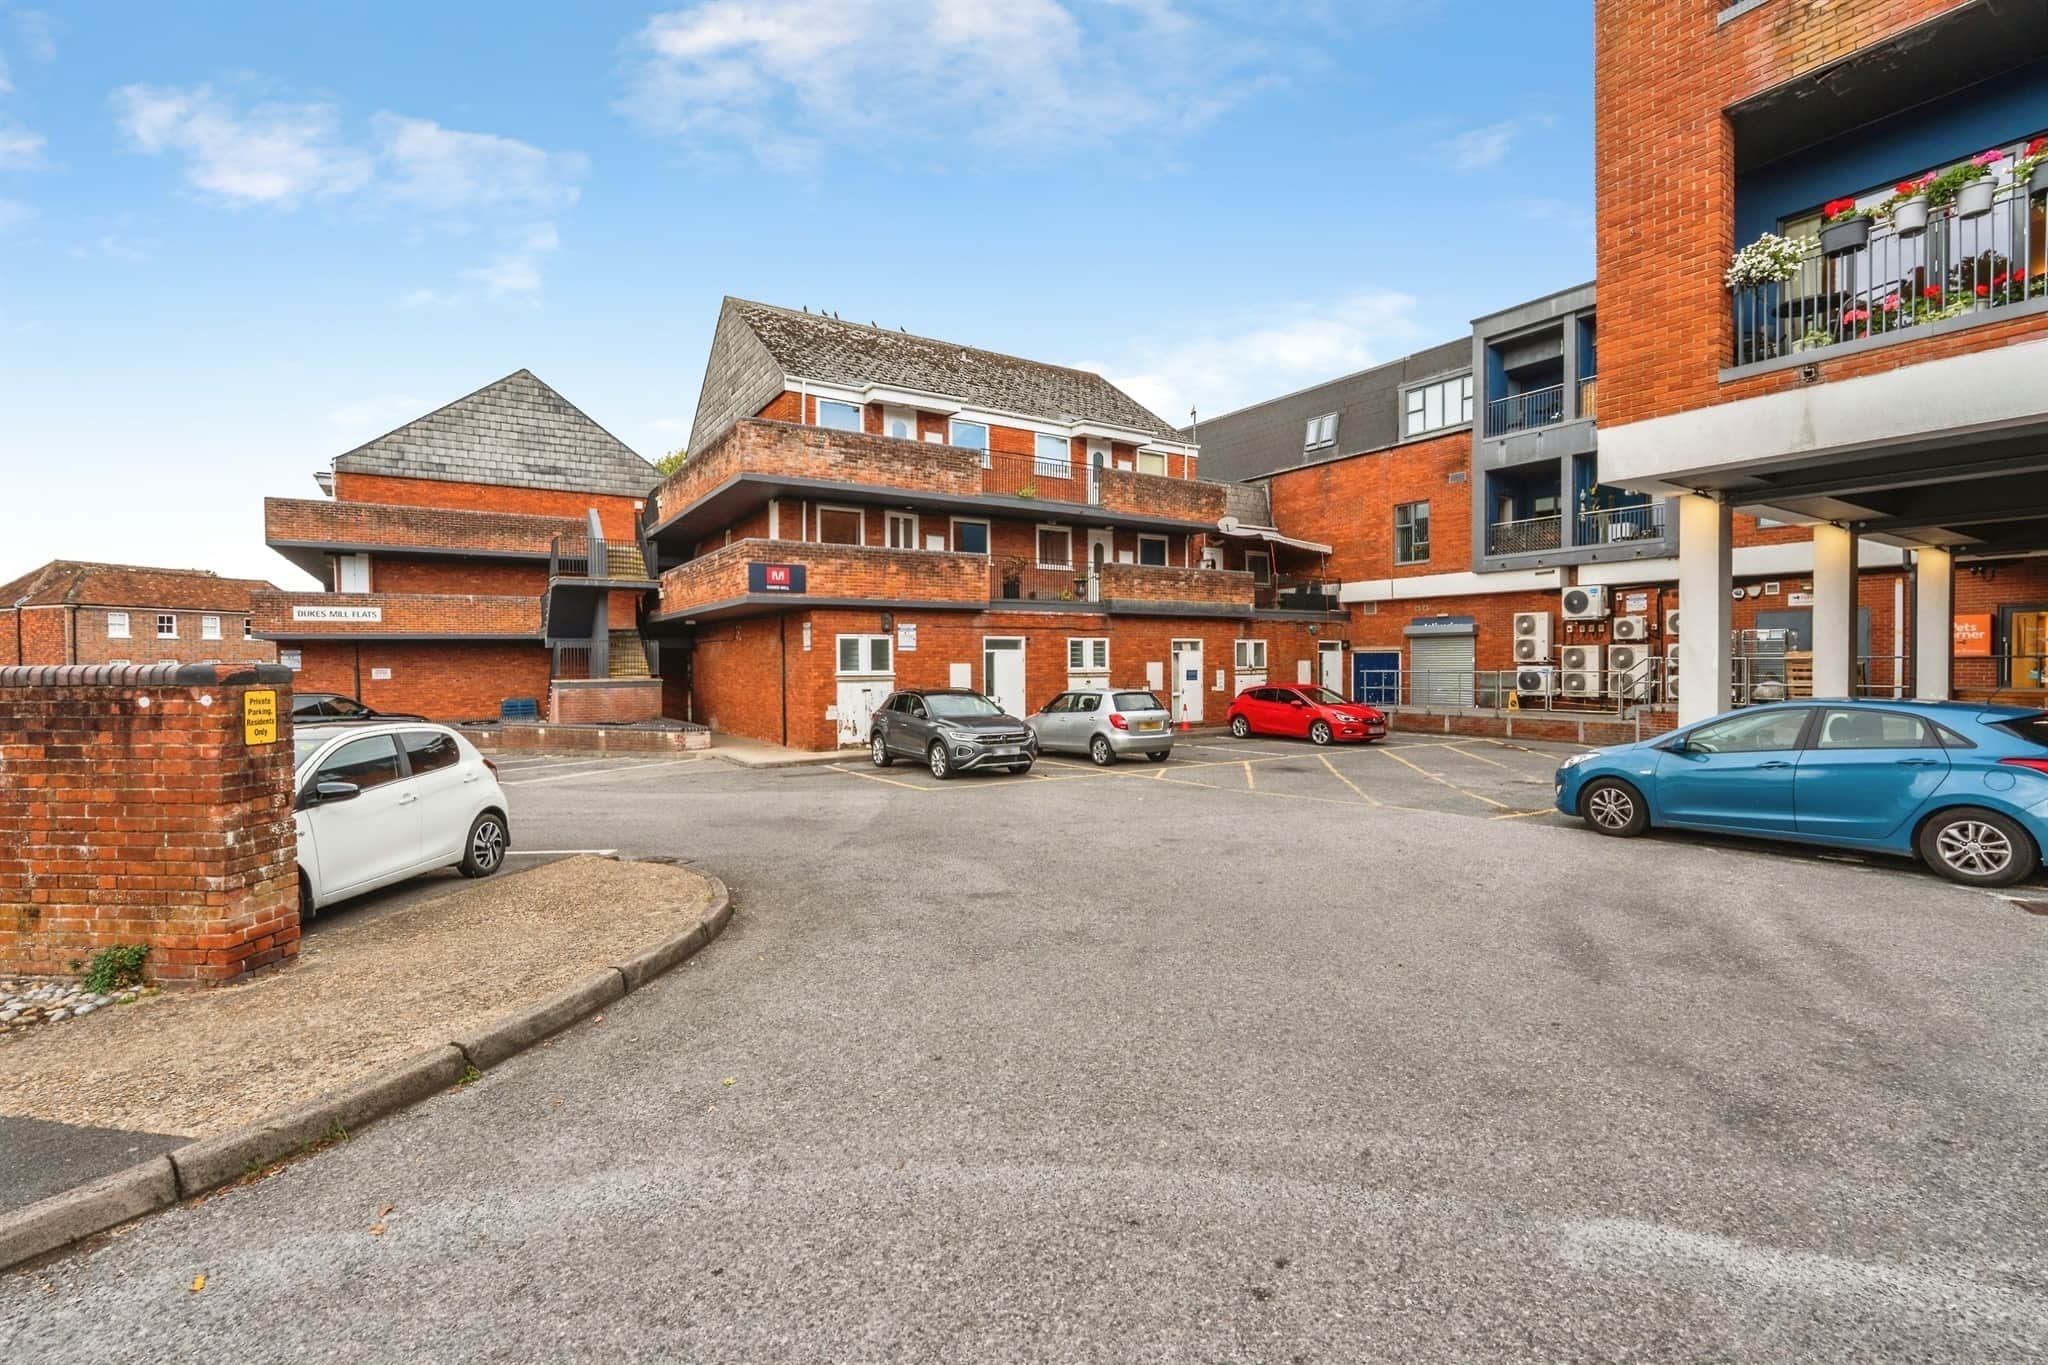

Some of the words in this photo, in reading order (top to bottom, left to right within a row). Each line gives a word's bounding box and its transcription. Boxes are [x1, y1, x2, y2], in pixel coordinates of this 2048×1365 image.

[771, 570, 785, 581] M
[249, 697, 271, 705] Private
[246, 718, 275, 726] Residents
[254, 727, 268, 737] Only
